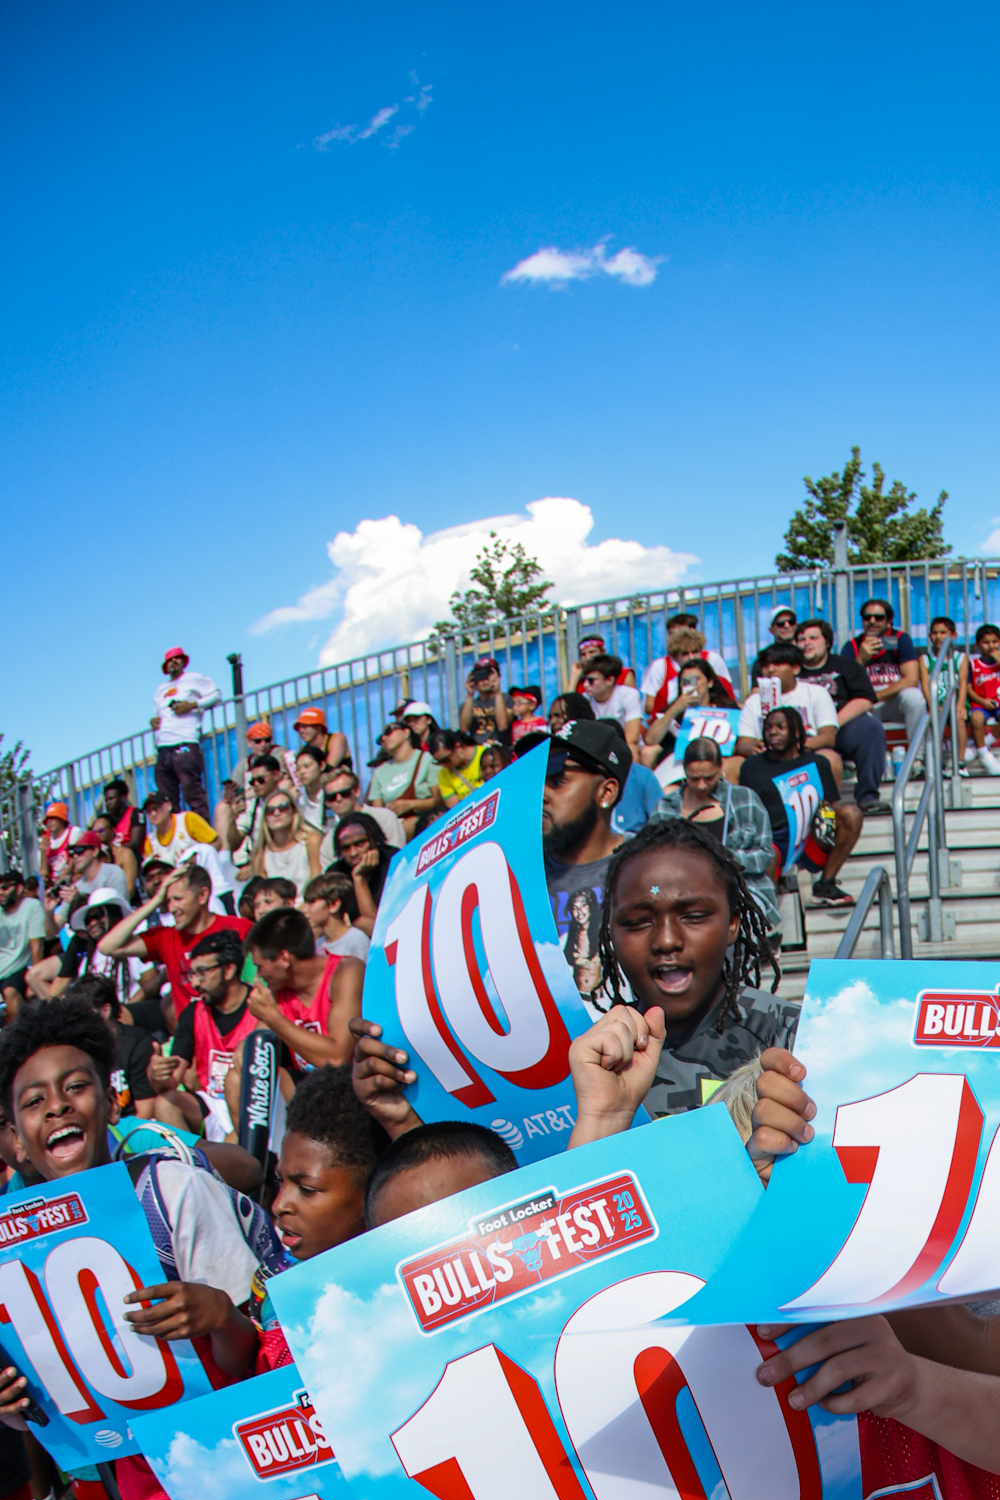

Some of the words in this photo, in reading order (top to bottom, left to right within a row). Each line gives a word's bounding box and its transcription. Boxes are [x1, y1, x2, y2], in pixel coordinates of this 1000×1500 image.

[688, 718, 732, 744] 10
[418, 832, 452, 870] BULLS
[459, 805, 487, 840] FEST
[790, 784, 819, 849] 10
[384, 841, 572, 1109] 10
[249, 1041, 276, 1079] Sox
[246, 1078, 270, 1131] White
[522, 1104, 576, 1139] AT&T
[0, 1216, 28, 1242] ULLS
[36, 1203, 70, 1228] FEST
[478, 1215, 509, 1237] Foot
[508, 1196, 554, 1224] Locker
[620, 1209, 642, 1231] 25
[413, 1240, 514, 1317] BULLS
[541, 1198, 615, 1261] FEST
[612, 1191, 635, 1213] 20
[0, 1236, 184, 1425] 10
[247, 1413, 331, 1468] BULLS
